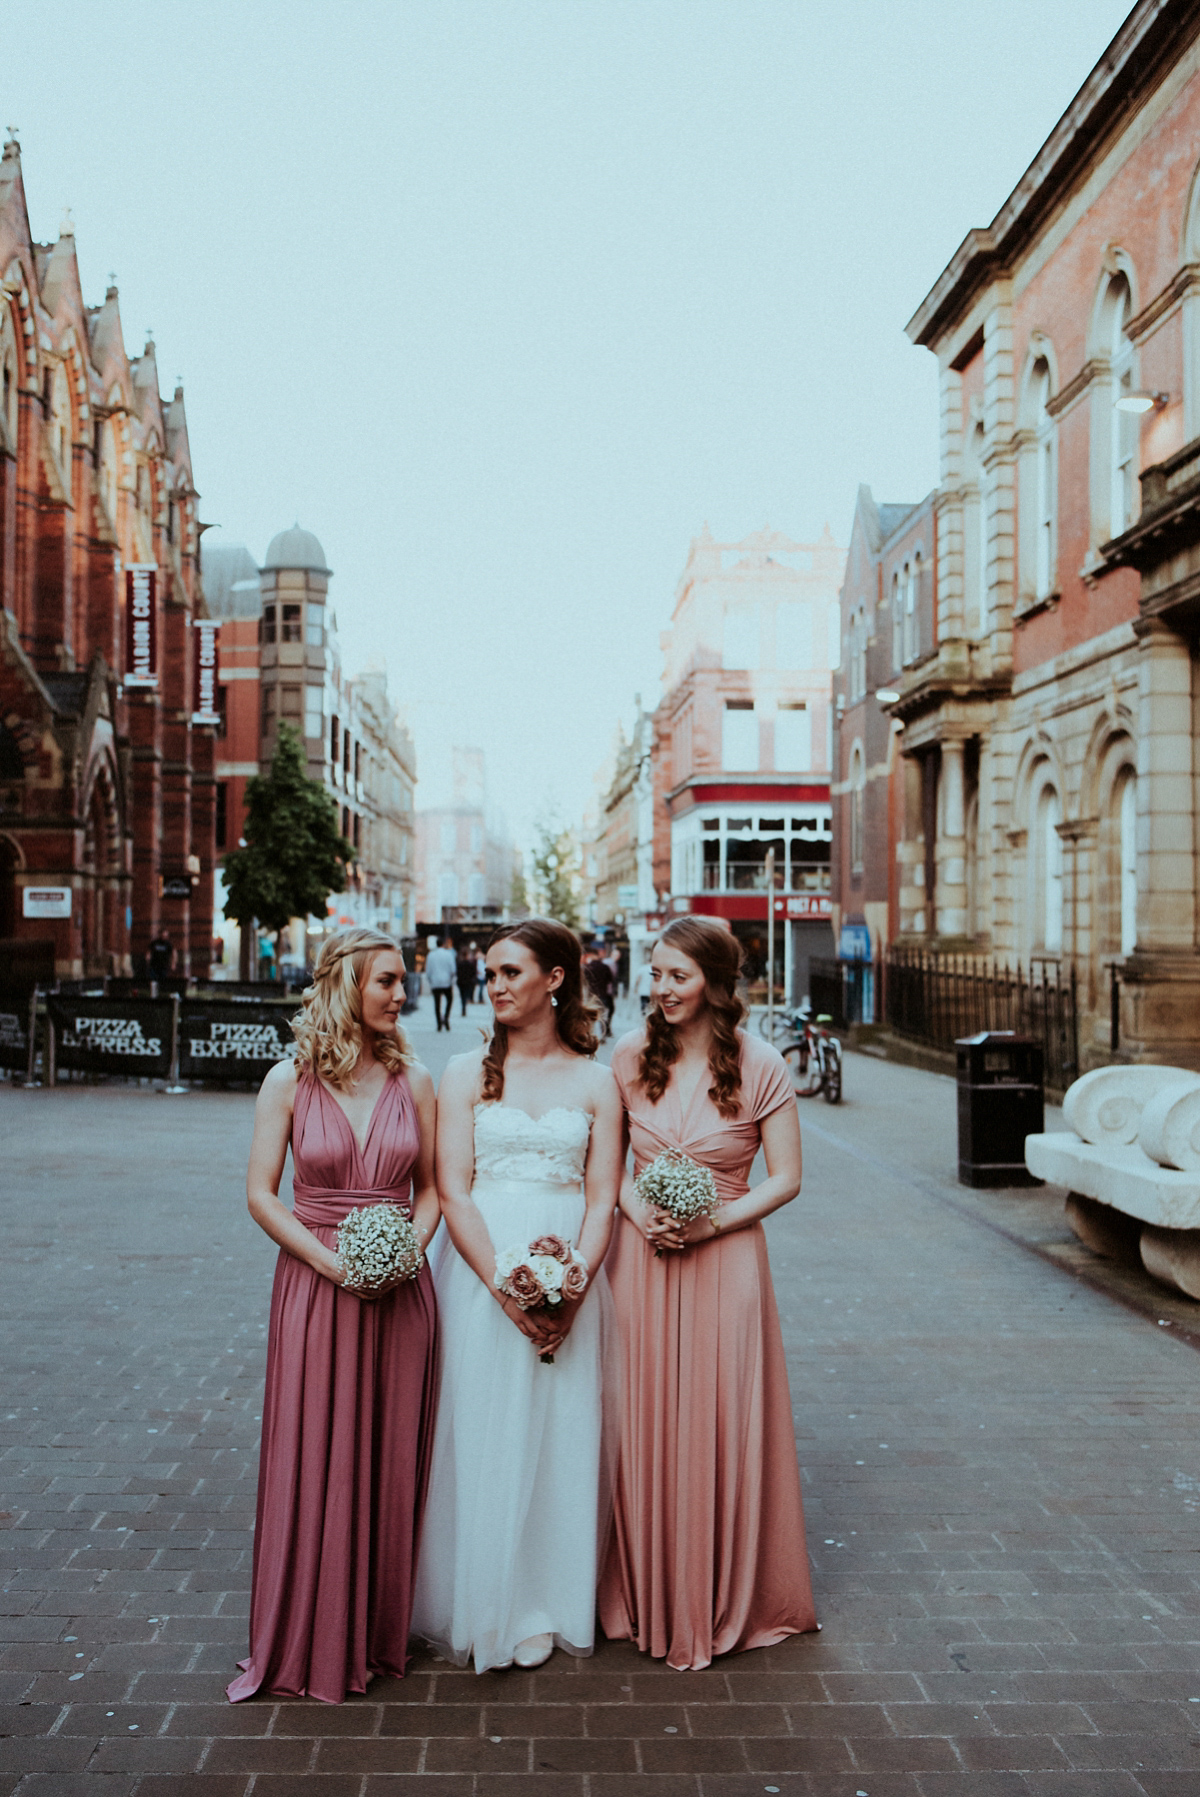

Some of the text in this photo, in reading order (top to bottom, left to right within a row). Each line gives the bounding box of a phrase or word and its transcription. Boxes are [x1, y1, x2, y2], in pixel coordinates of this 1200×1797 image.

[132, 570, 151, 675] ALBION COURT
[199, 626, 216, 714] ALBION COURT
[75, 1017, 143, 1037] PIZZA
[210, 1022, 279, 1042] PIZZA
[62, 1029, 162, 1057] EPRESS
[189, 1039, 299, 1060] EXPRESS
